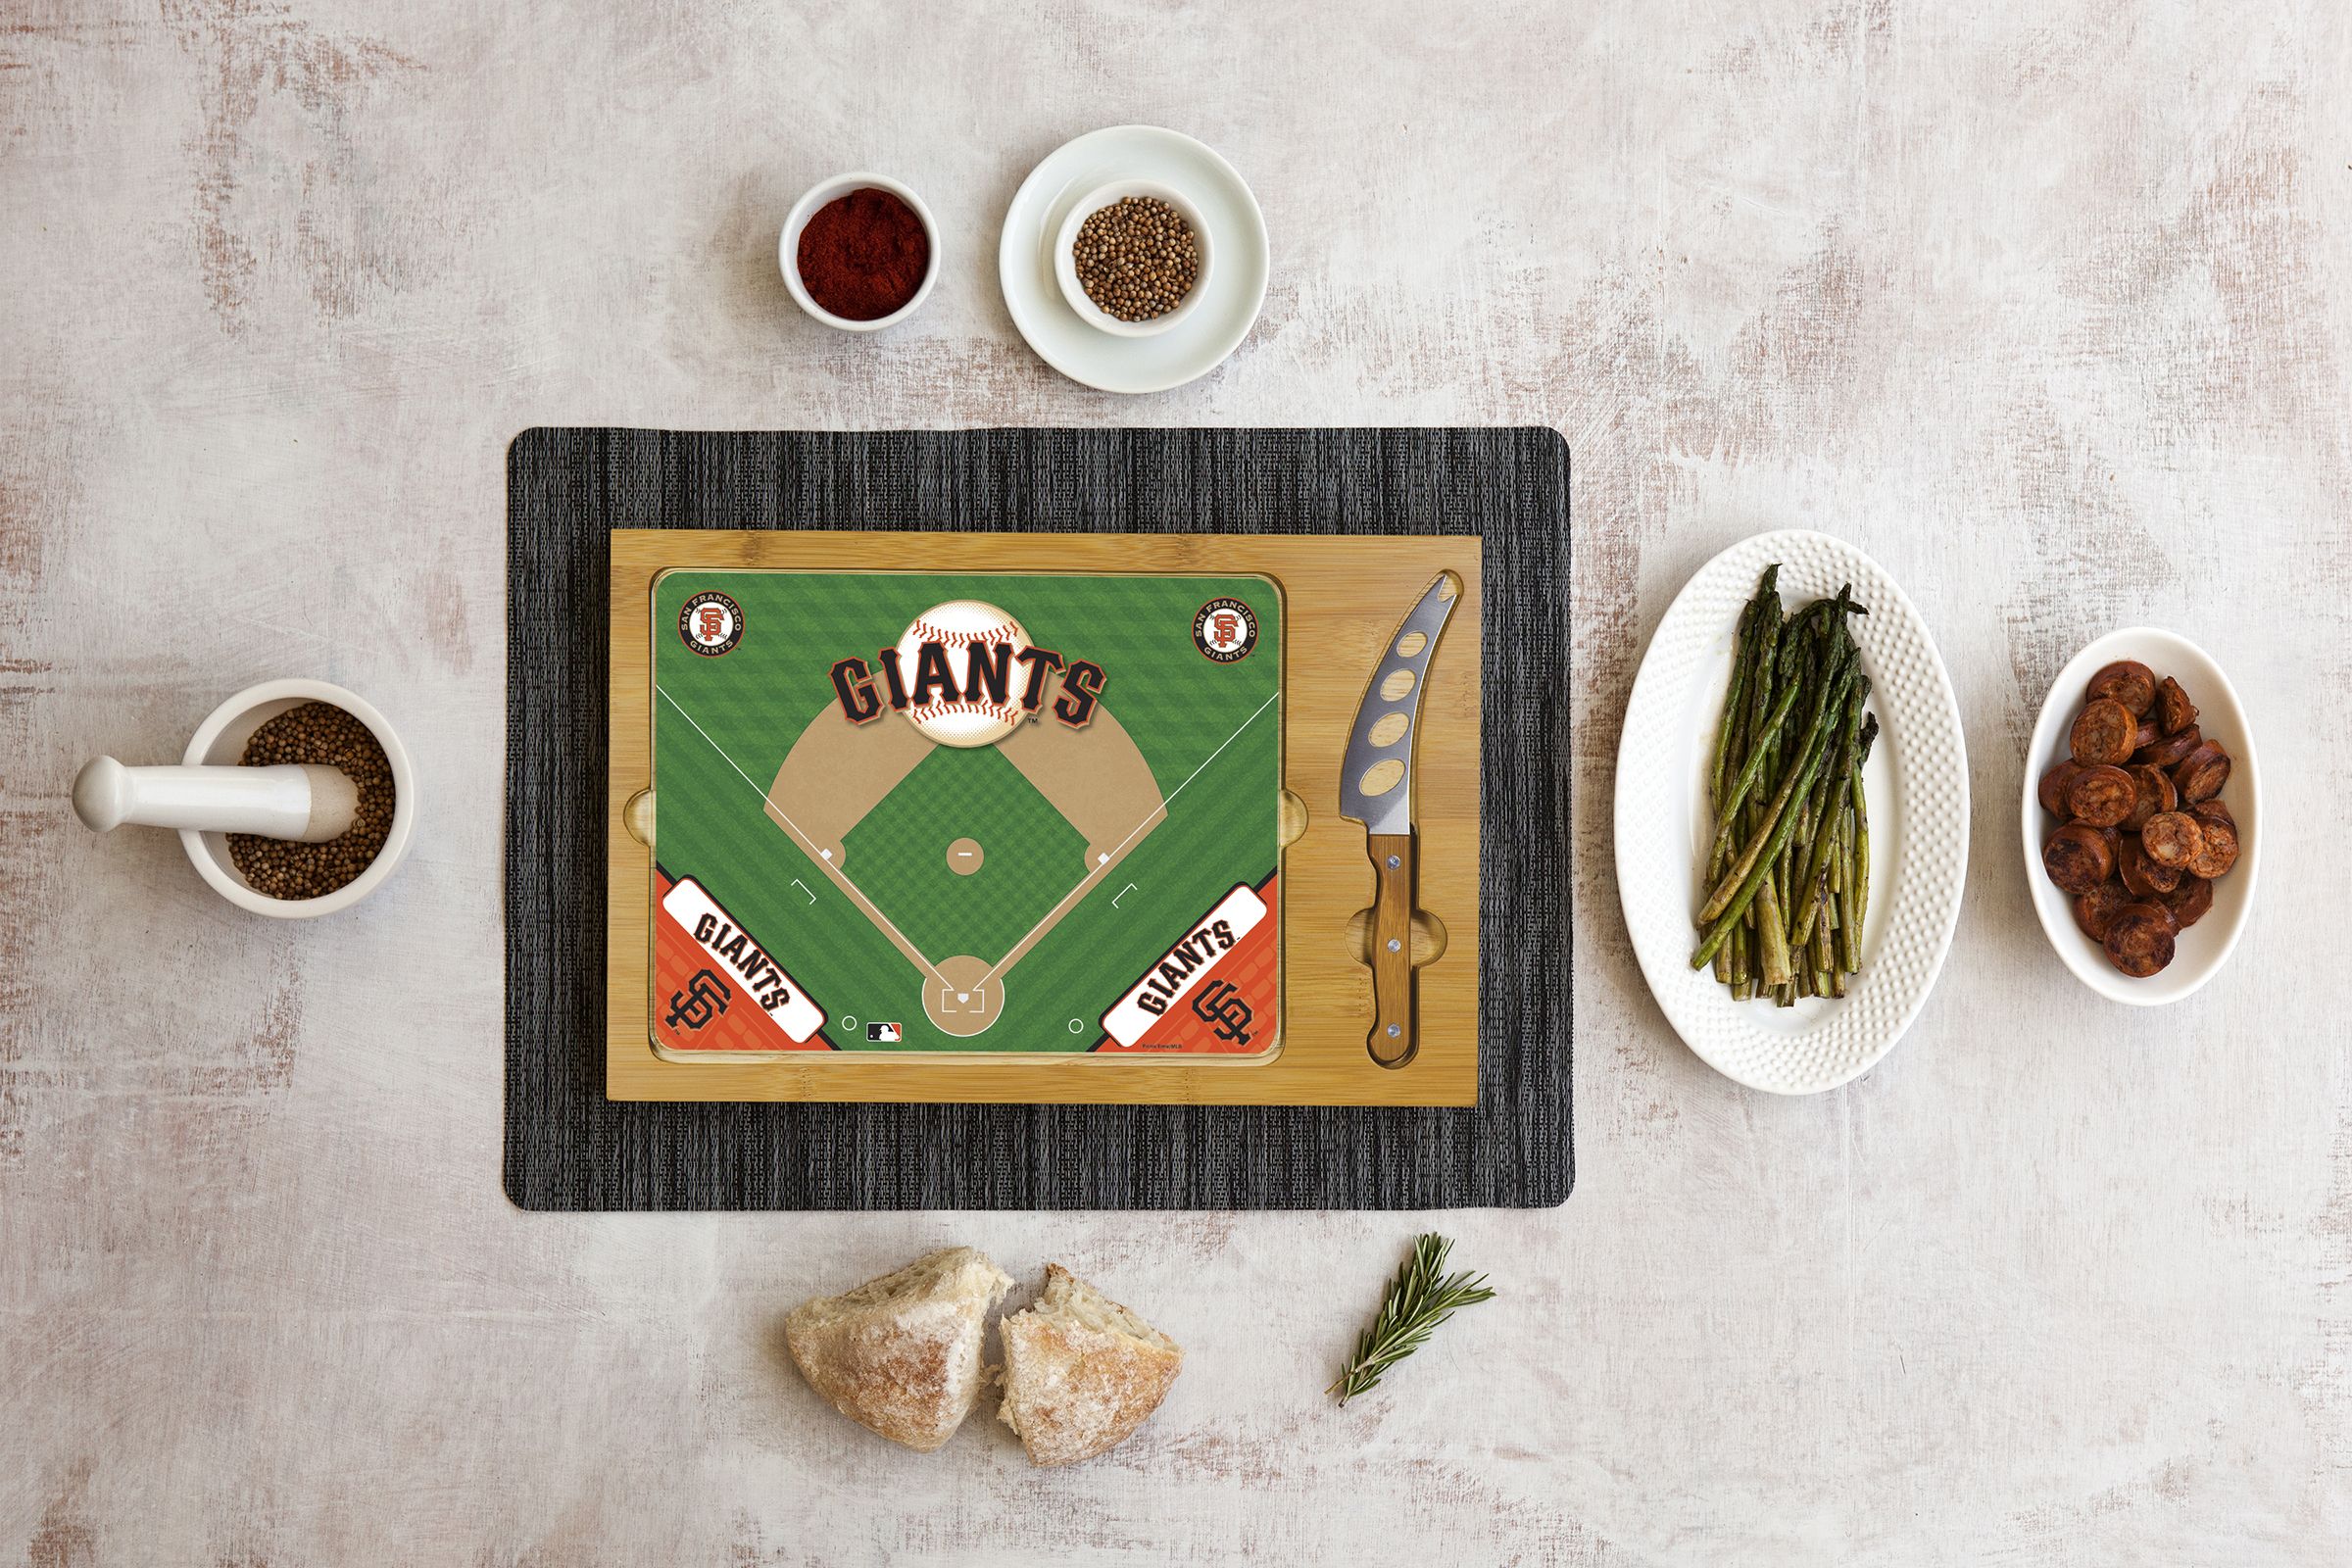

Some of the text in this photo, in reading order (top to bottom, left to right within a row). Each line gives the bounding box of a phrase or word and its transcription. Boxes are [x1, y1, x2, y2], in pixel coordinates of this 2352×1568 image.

[681, 594, 742, 631] SAN FRANCISCO
[1196, 600, 1255, 637] SAN FRANCISCO
[690, 639, 733, 654] GIANTS
[1203, 646, 1248, 661] GIANTS
[827, 639, 1107, 730] GIANTS
[693, 912, 791, 1012] GIANTS
[1137, 919, 1237, 1016] GIANTS
